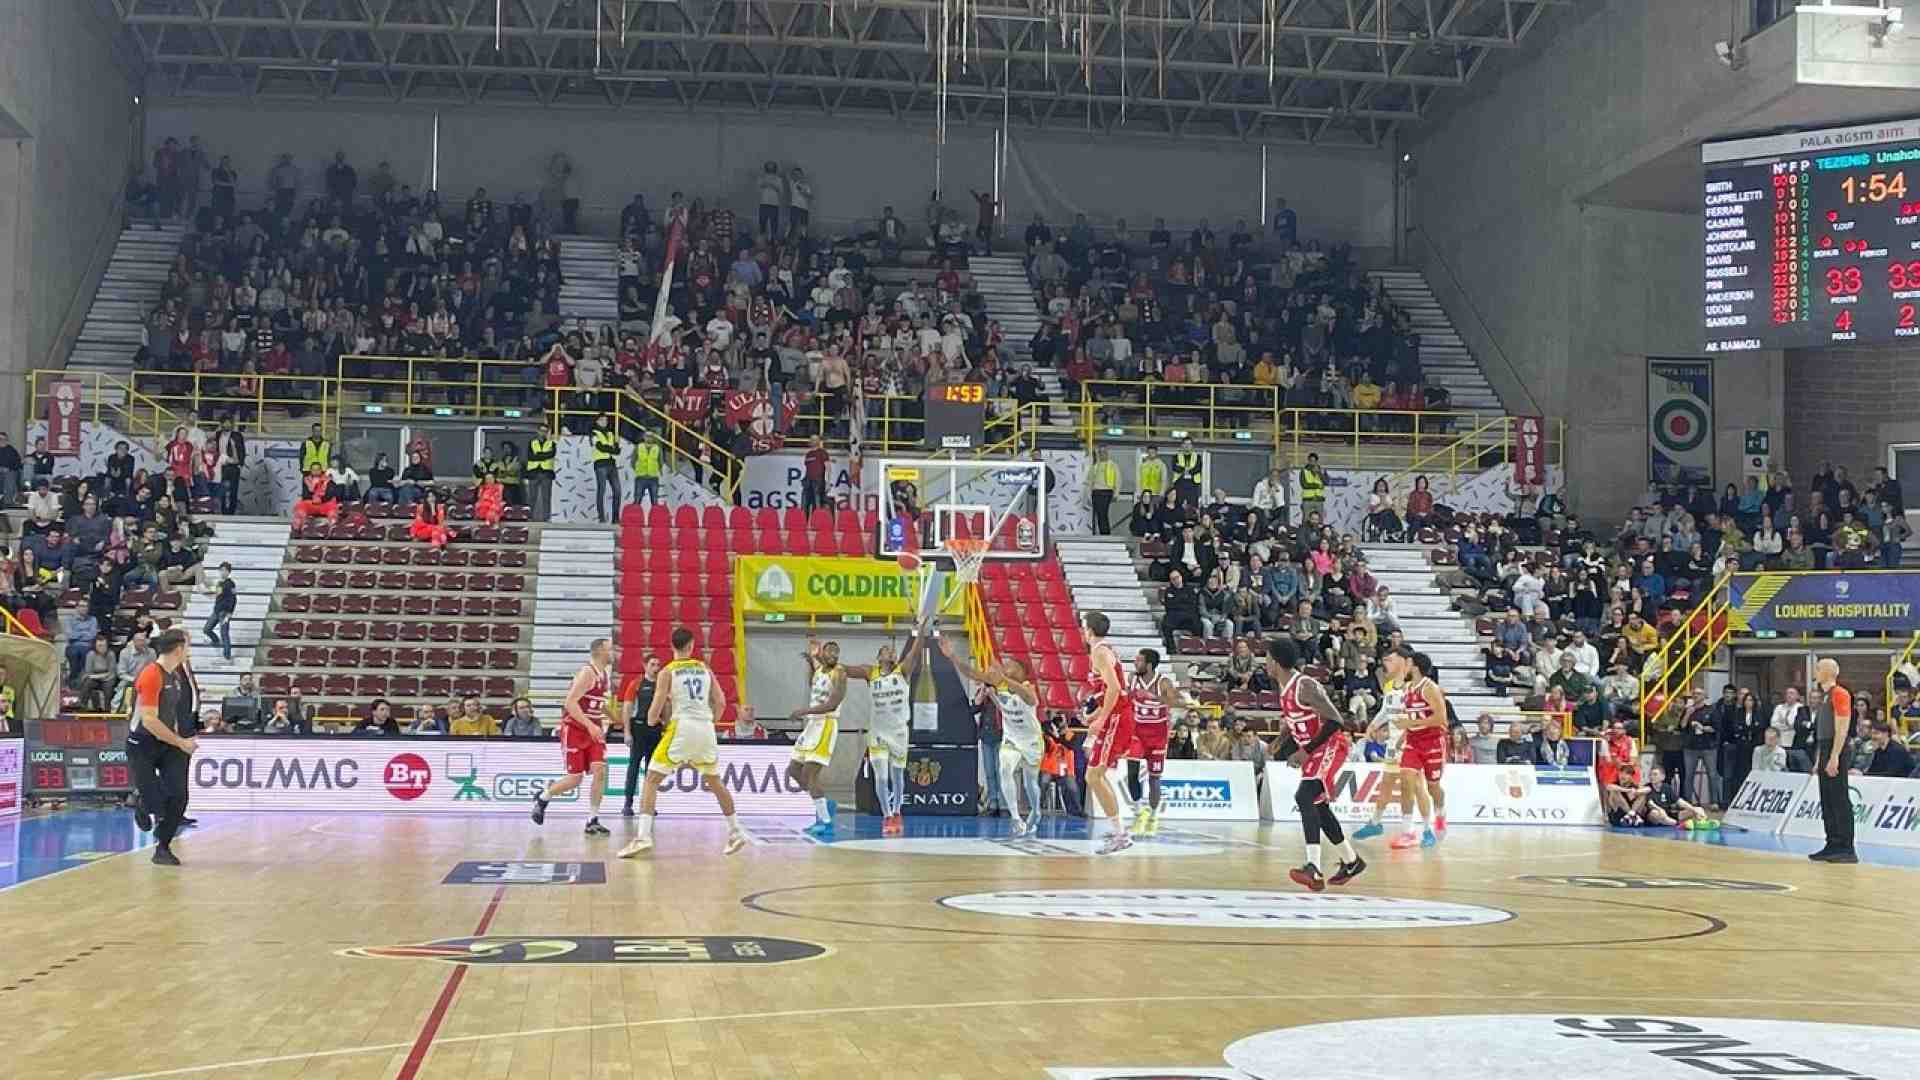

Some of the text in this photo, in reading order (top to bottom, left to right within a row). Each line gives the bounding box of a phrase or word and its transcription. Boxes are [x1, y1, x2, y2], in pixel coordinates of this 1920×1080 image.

[1800, 135, 1832, 148] PALA
[1789, 162, 1797, 172] F
[1800, 161, 1810, 172] P
[1789, 174, 1797, 184] 0
[1790, 187, 1796, 197] 1
[1841, 171, 1907, 204] 1:54
[1789, 199, 1797, 209] 0
[1790, 211, 1796, 221] 1
[1790, 224, 1796, 234] 1
[1789, 237, 1797, 246] 2
[1789, 249, 1797, 259] 2
[1789, 262, 1797, 272] 0
[1789, 274, 1797, 284] 0
[1826, 267, 1862, 294] 33
[1889, 262, 1920, 289] 33
[1789, 286, 1797, 296] 2
[1789, 299, 1797, 309] 0
[1790, 311, 1796, 321] 1
[1836, 310, 1852, 331] 4
[1900, 304, 1915, 327] 2
[946, 385, 983, 401] 1:53
[57, 385, 75, 449] AVIS
[1775, 603, 1911, 618] LOUNGE HOSPITALITY
[683, 678, 703, 700] 12
[195, 758, 360, 789] COLMAC
[1159, 783, 1224, 800] entax
[1473, 804, 1567, 819] ZENATO
